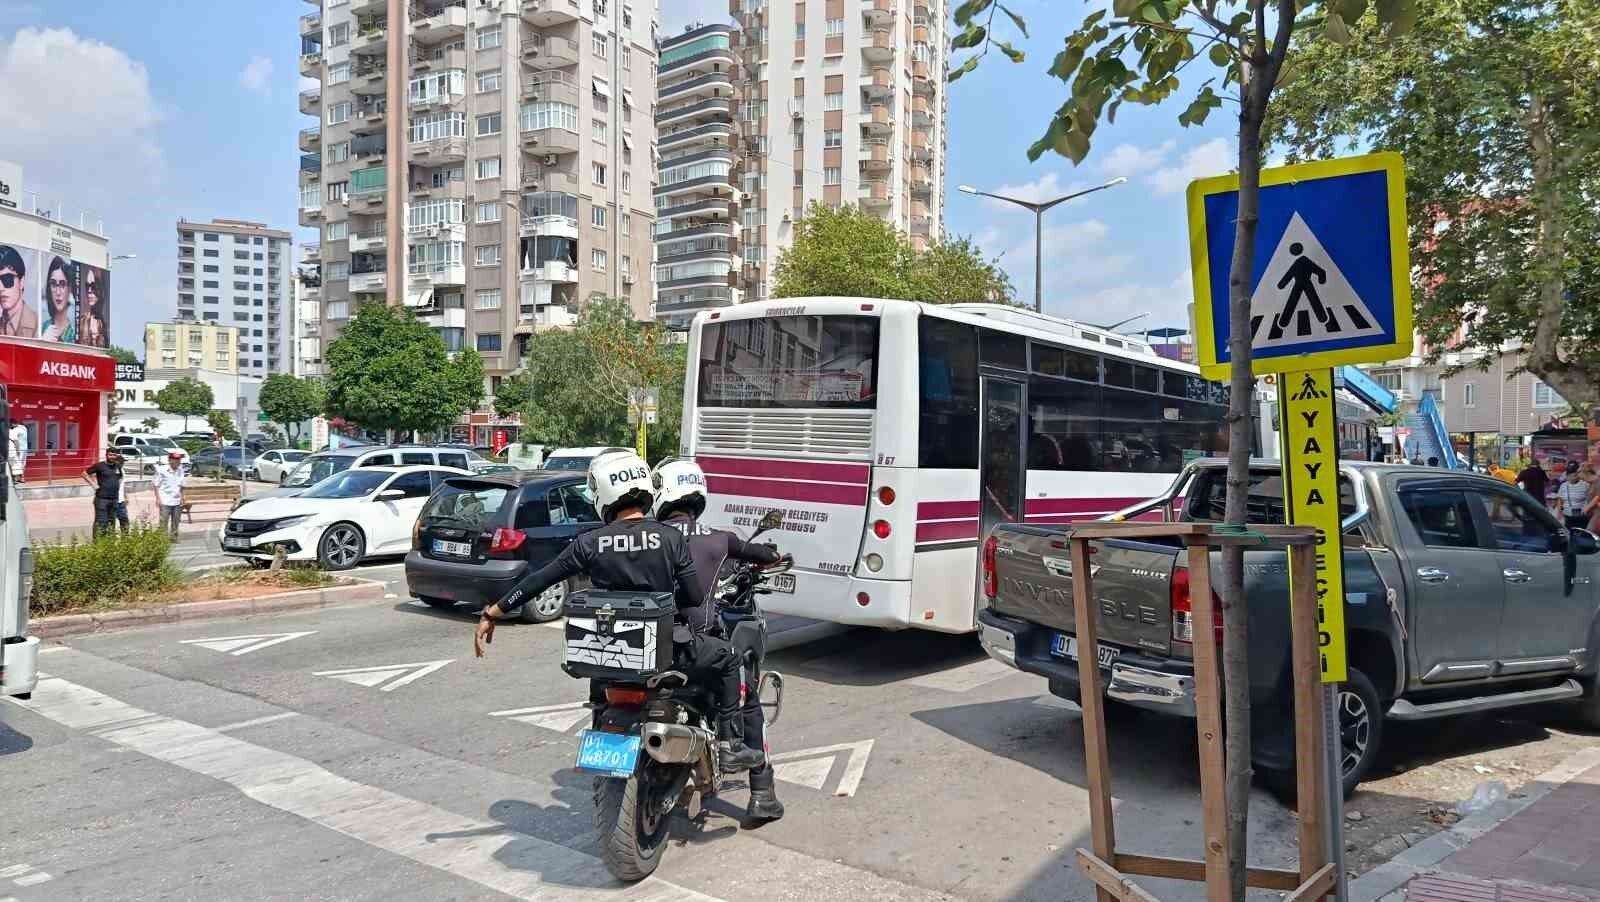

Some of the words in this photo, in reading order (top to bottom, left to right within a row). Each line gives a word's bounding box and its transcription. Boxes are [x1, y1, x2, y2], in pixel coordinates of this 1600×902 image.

[40, 361, 96, 380] AKBANK
[1301, 410, 1324, 506] YAYA
[609, 467, 647, 486] POLİS
[779, 520, 817, 534] TOBÜSÜ
[818, 561, 852, 572] MURAT
[774, 575, 794, 588] 0167
[1004, 576, 1160, 627] INVINBLE
[1058, 636, 1071, 653] 01
